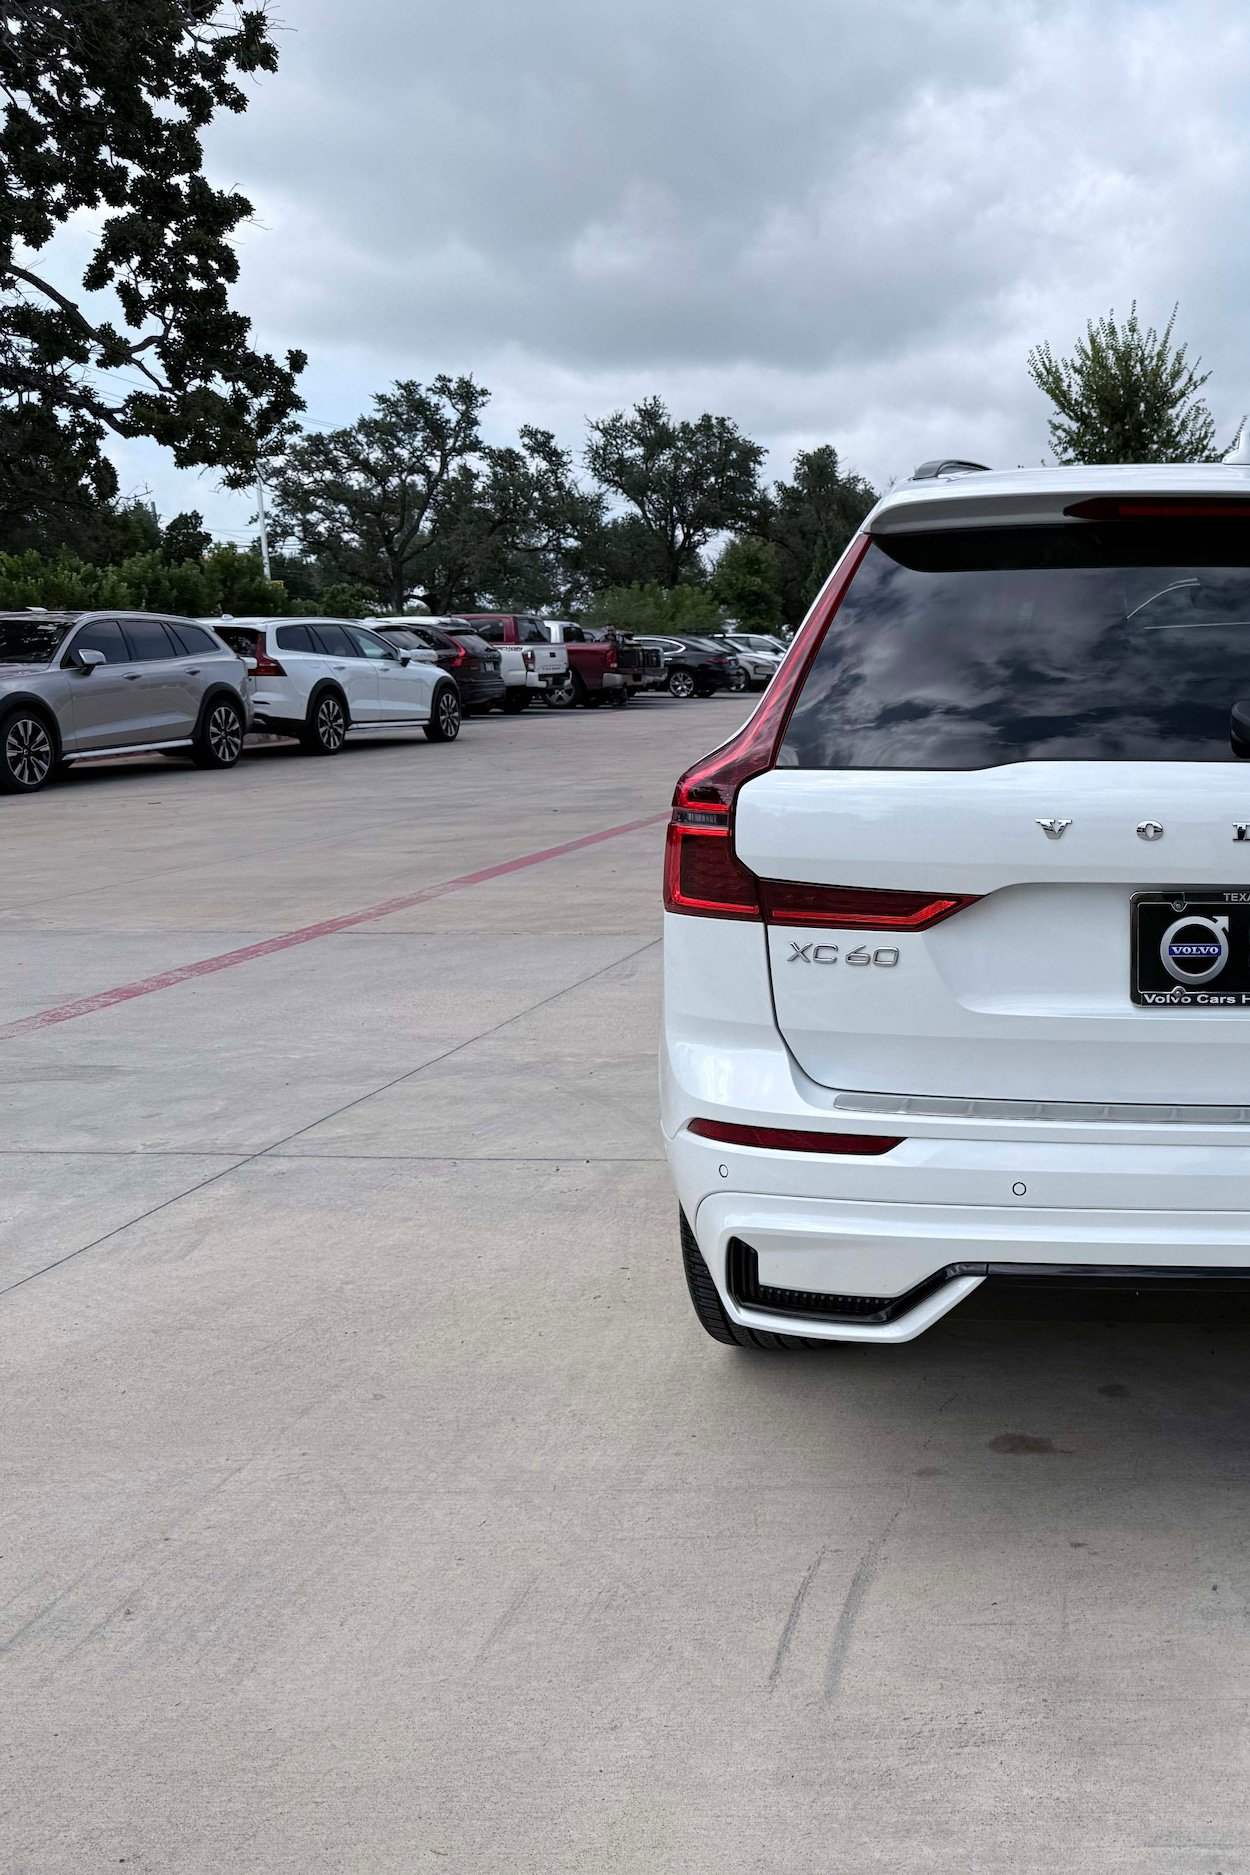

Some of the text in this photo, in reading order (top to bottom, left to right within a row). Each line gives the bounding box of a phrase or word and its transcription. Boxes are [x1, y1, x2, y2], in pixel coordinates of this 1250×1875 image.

[787, 941, 900, 967] XC60
[1171, 946, 1219, 955] VOLVO
[1143, 993, 1192, 1004] Volvo
[1196, 994, 1236, 1004] Cars
